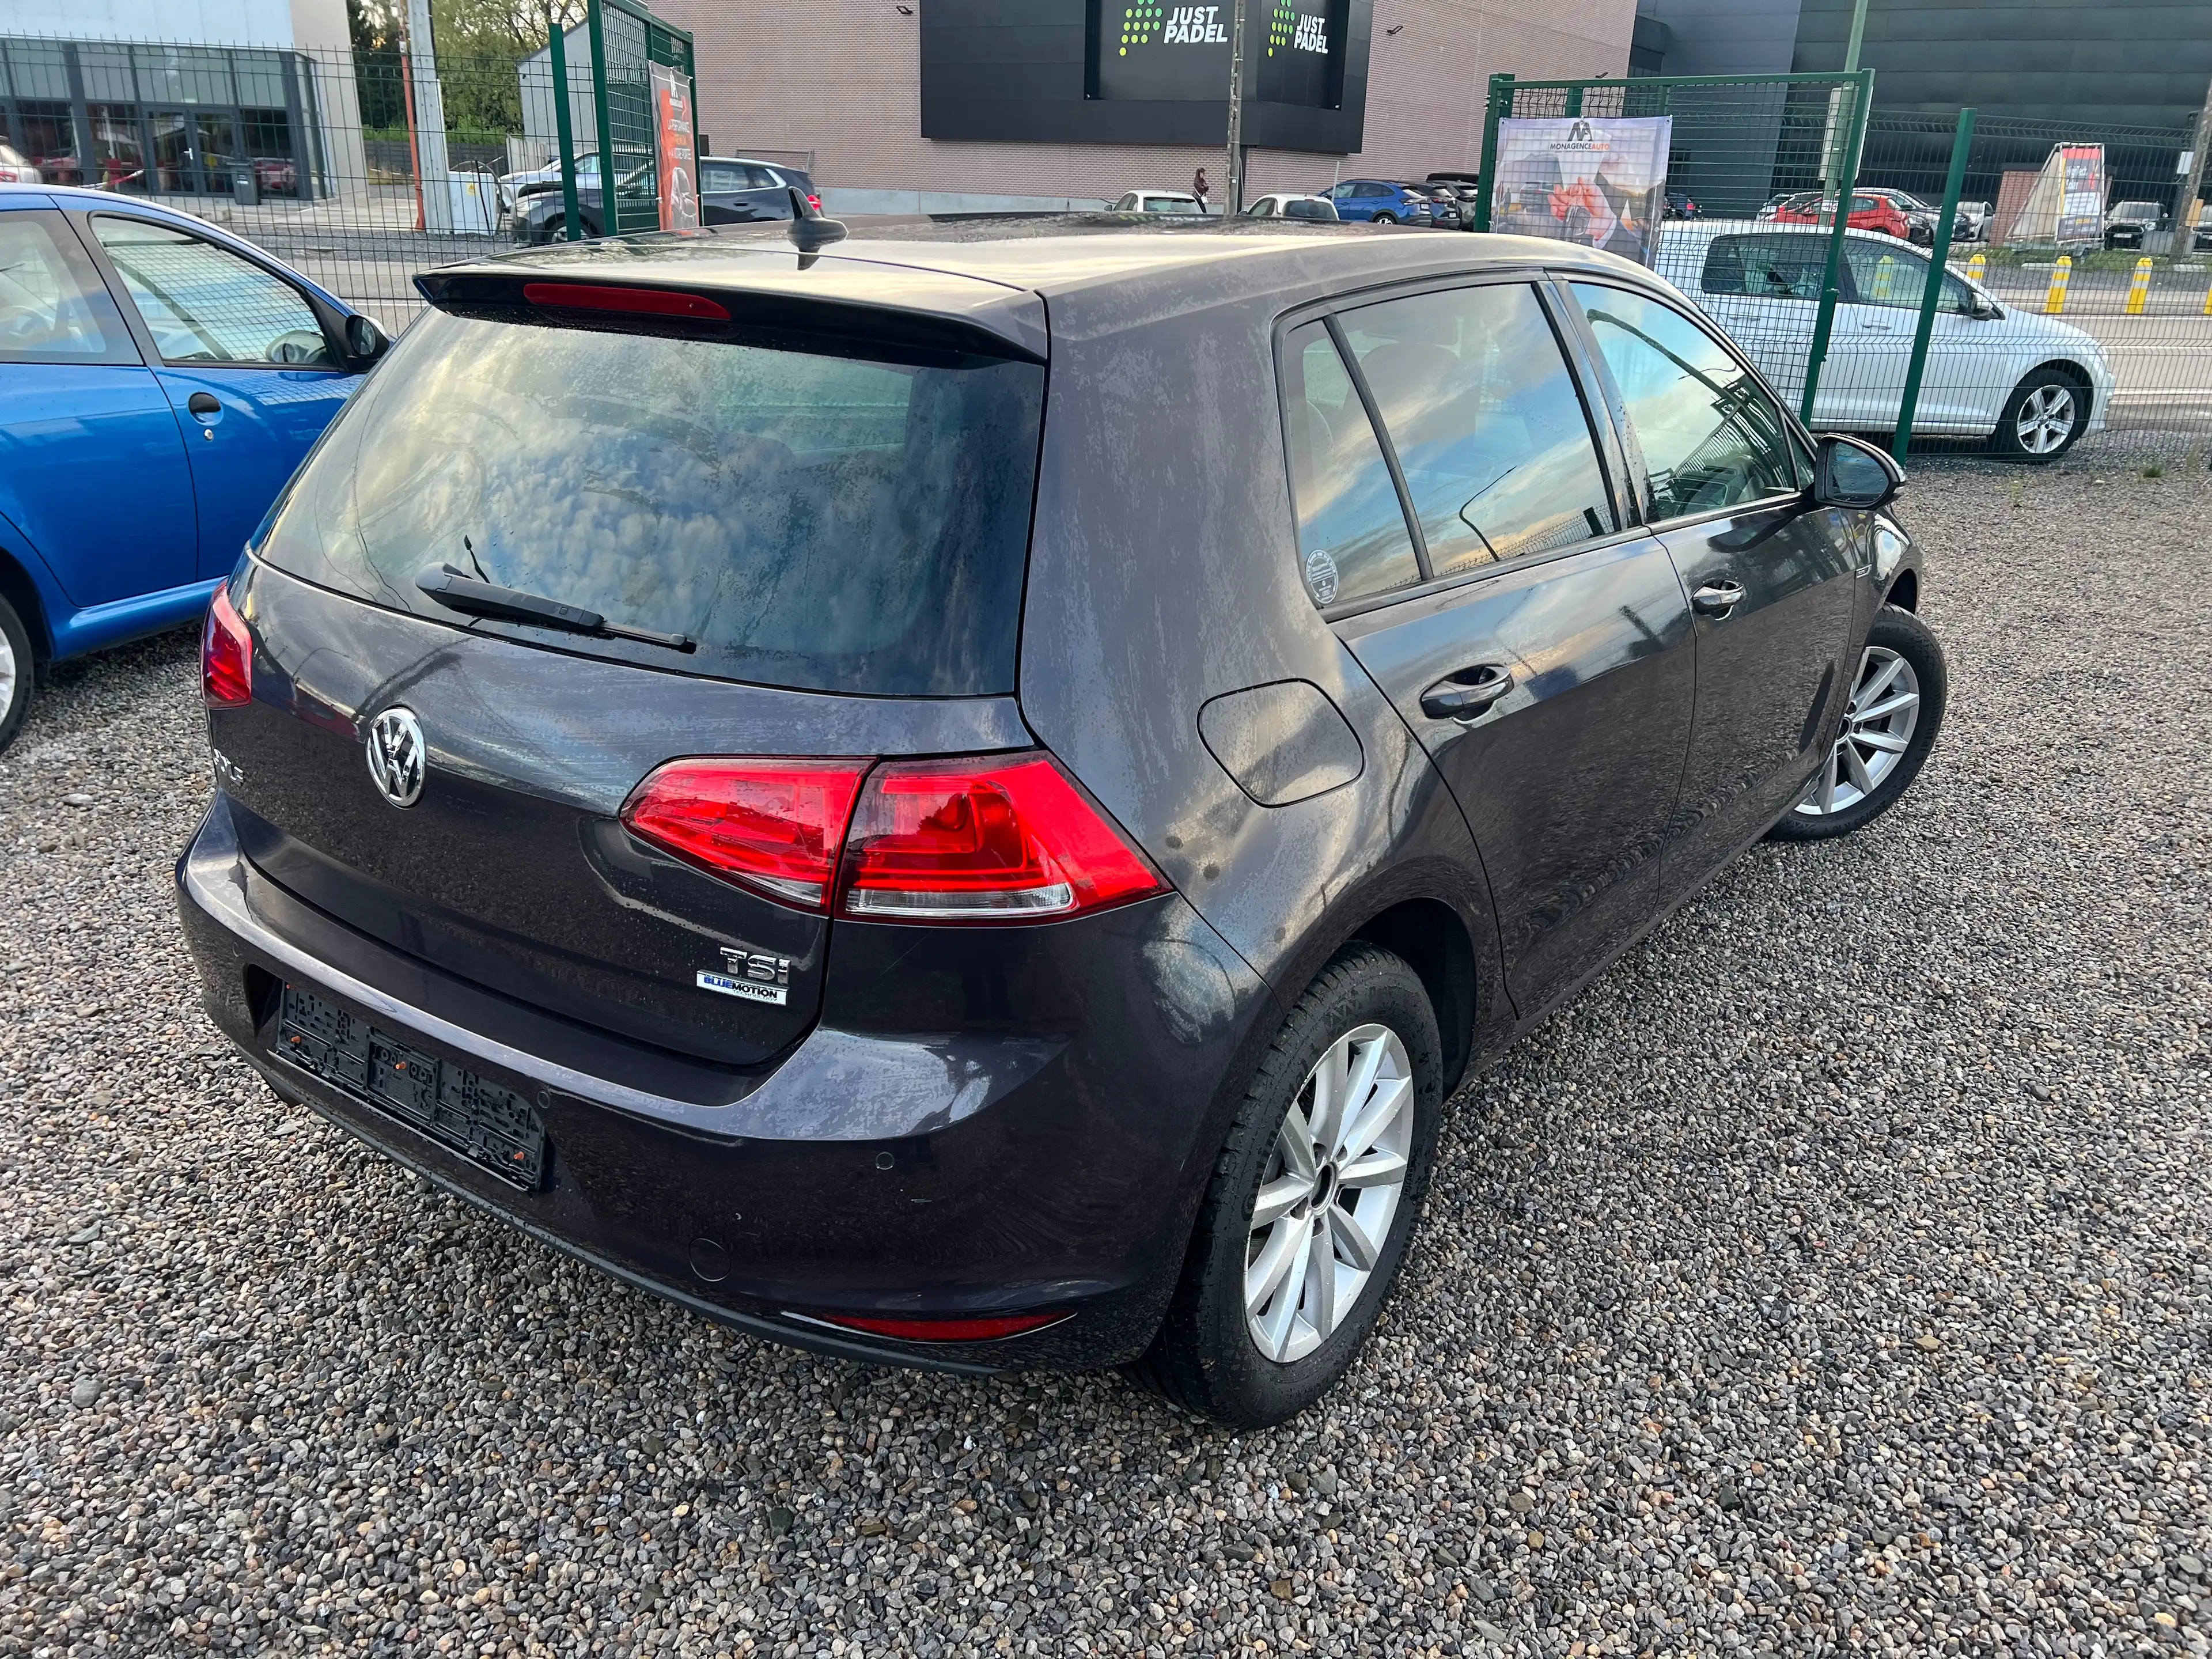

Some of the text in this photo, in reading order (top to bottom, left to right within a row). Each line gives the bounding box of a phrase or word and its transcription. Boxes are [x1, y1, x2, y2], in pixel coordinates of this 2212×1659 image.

[1167, 6, 1219, 25] JUST
[1296, 14, 1325, 35] JUST
[1164, 24, 1228, 43] PADEL
[1294, 31, 1328, 54] PADEL
[719, 946, 791, 984] TSI
[704, 975, 778, 998] BLUEMOTION
